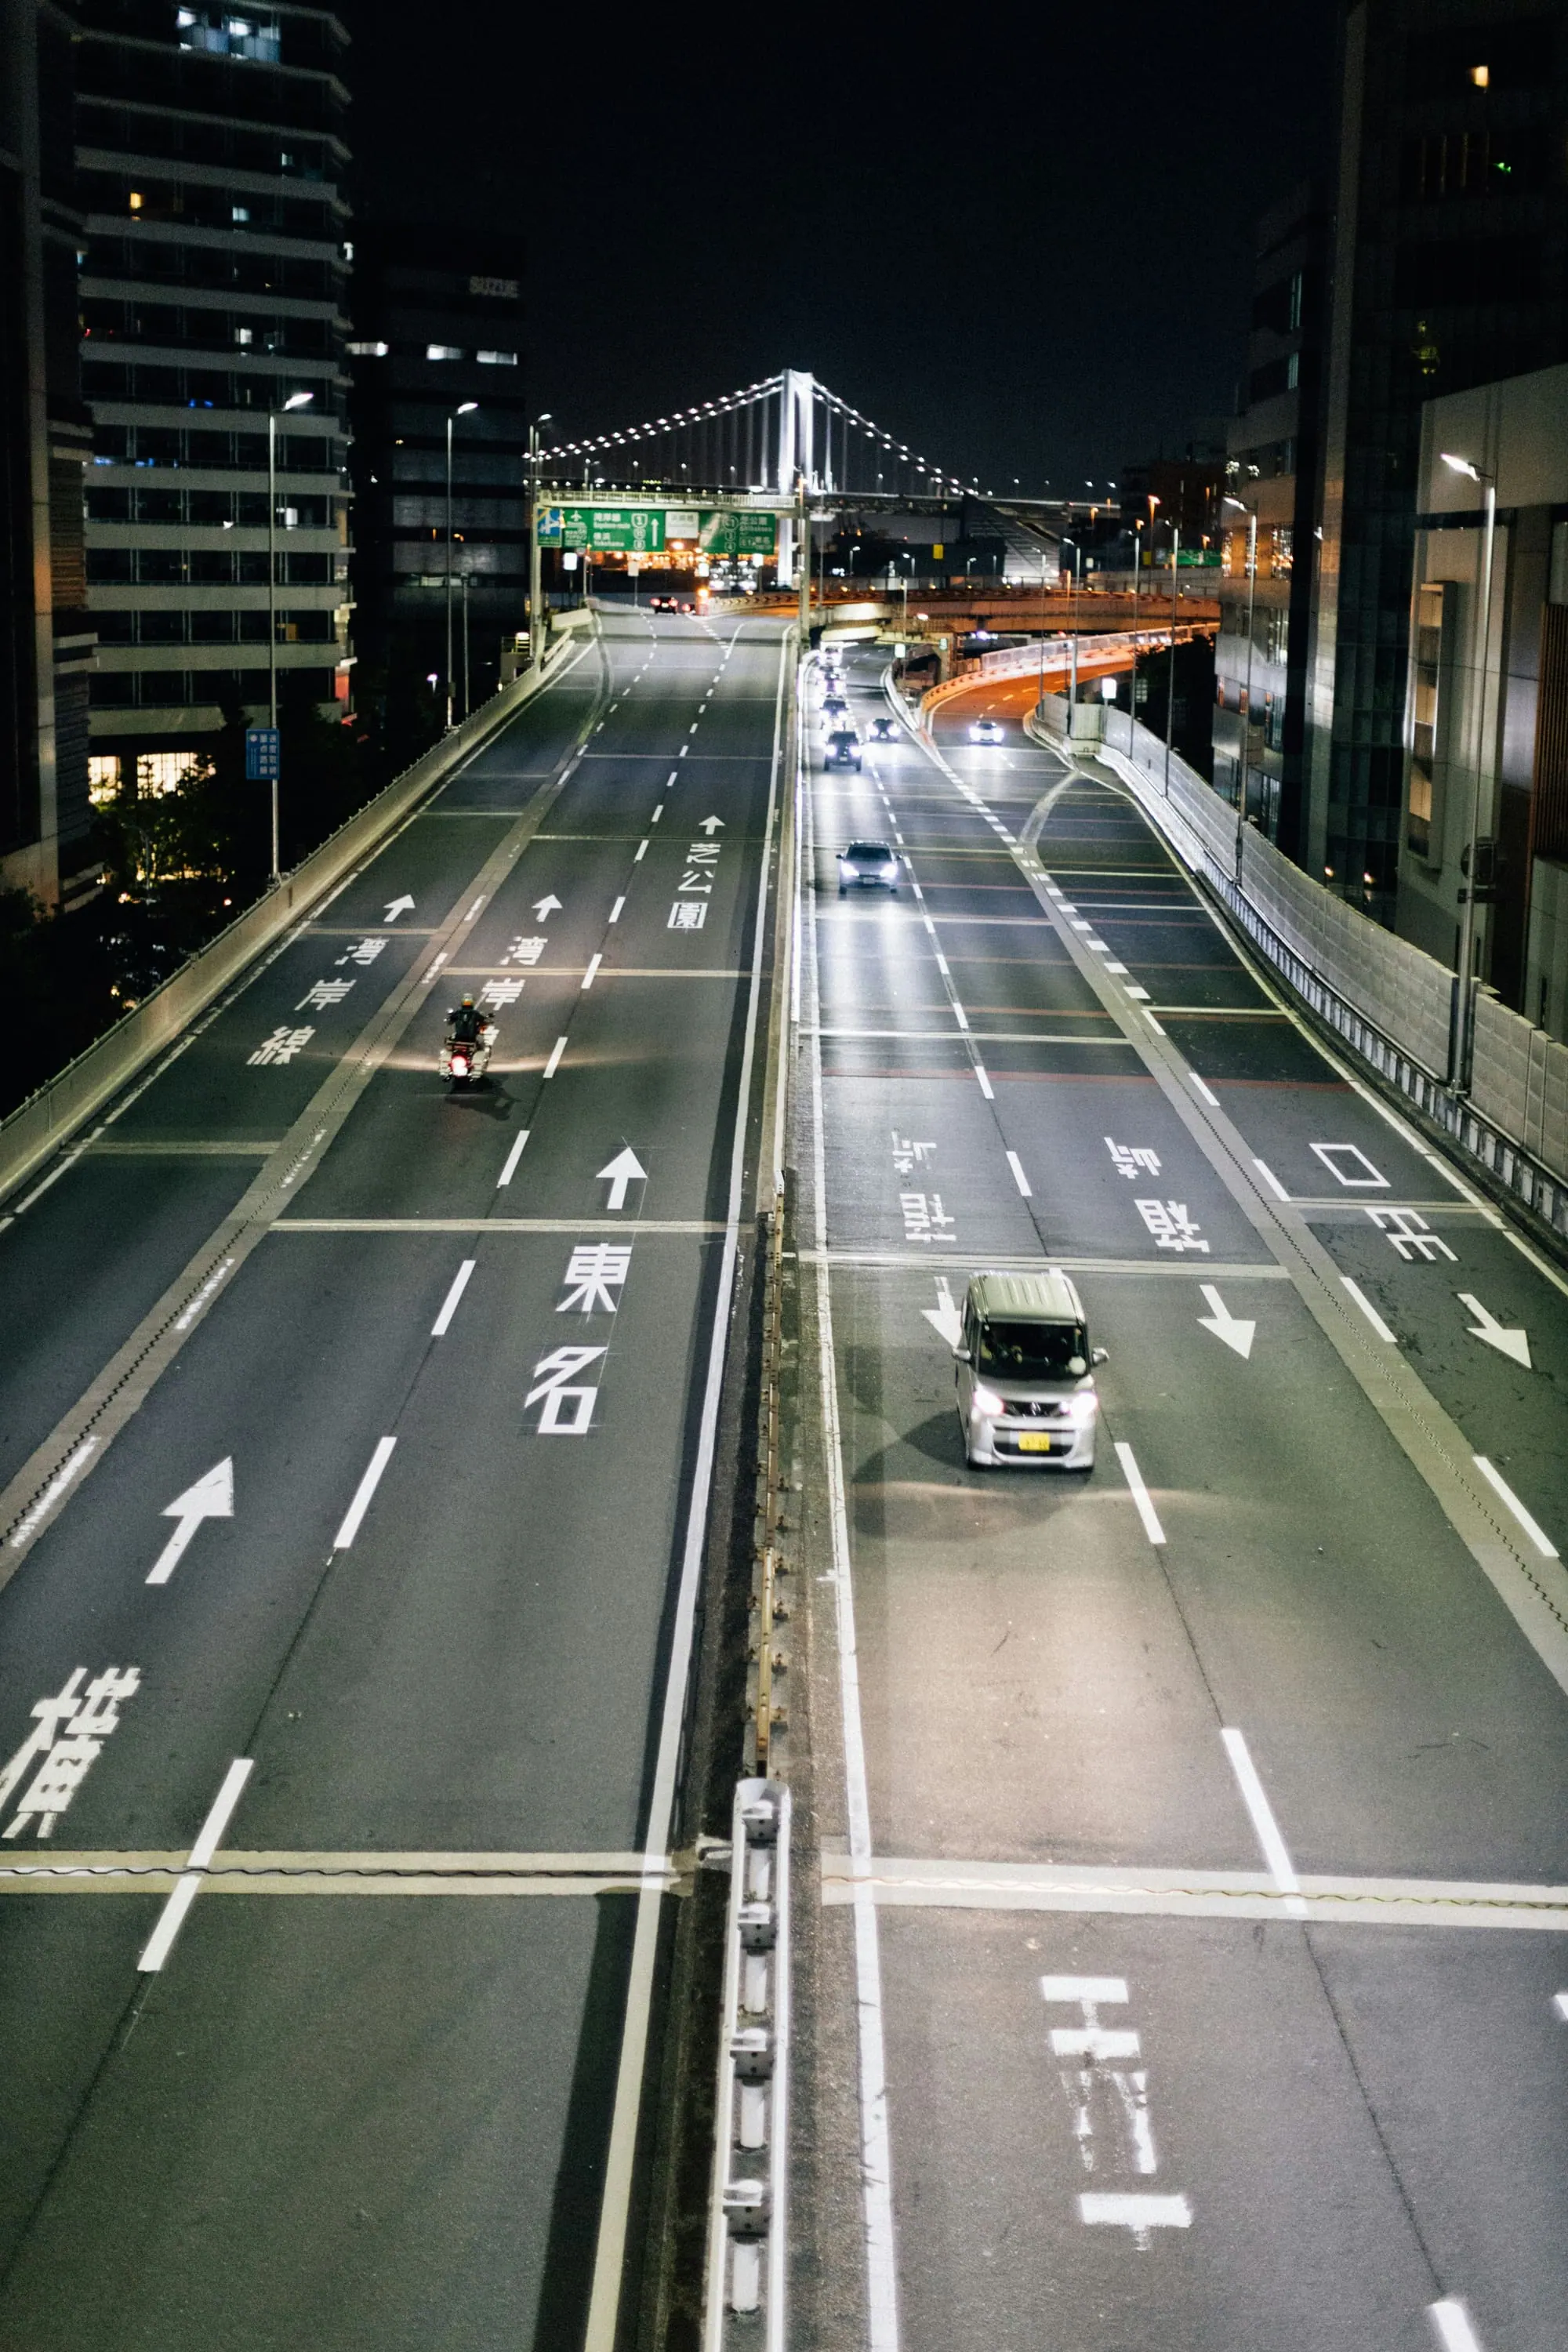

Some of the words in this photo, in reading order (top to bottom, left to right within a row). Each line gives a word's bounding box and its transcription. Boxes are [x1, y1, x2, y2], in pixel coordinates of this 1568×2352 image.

[667, 844, 721, 929] 芝公園
[246, 937, 390, 1065] 湾岸線
[1103, 1137, 1210, 1253] 箱崎
[1309, 1143, 1459, 1261] 出口
[524, 1243, 633, 1435] 東名
